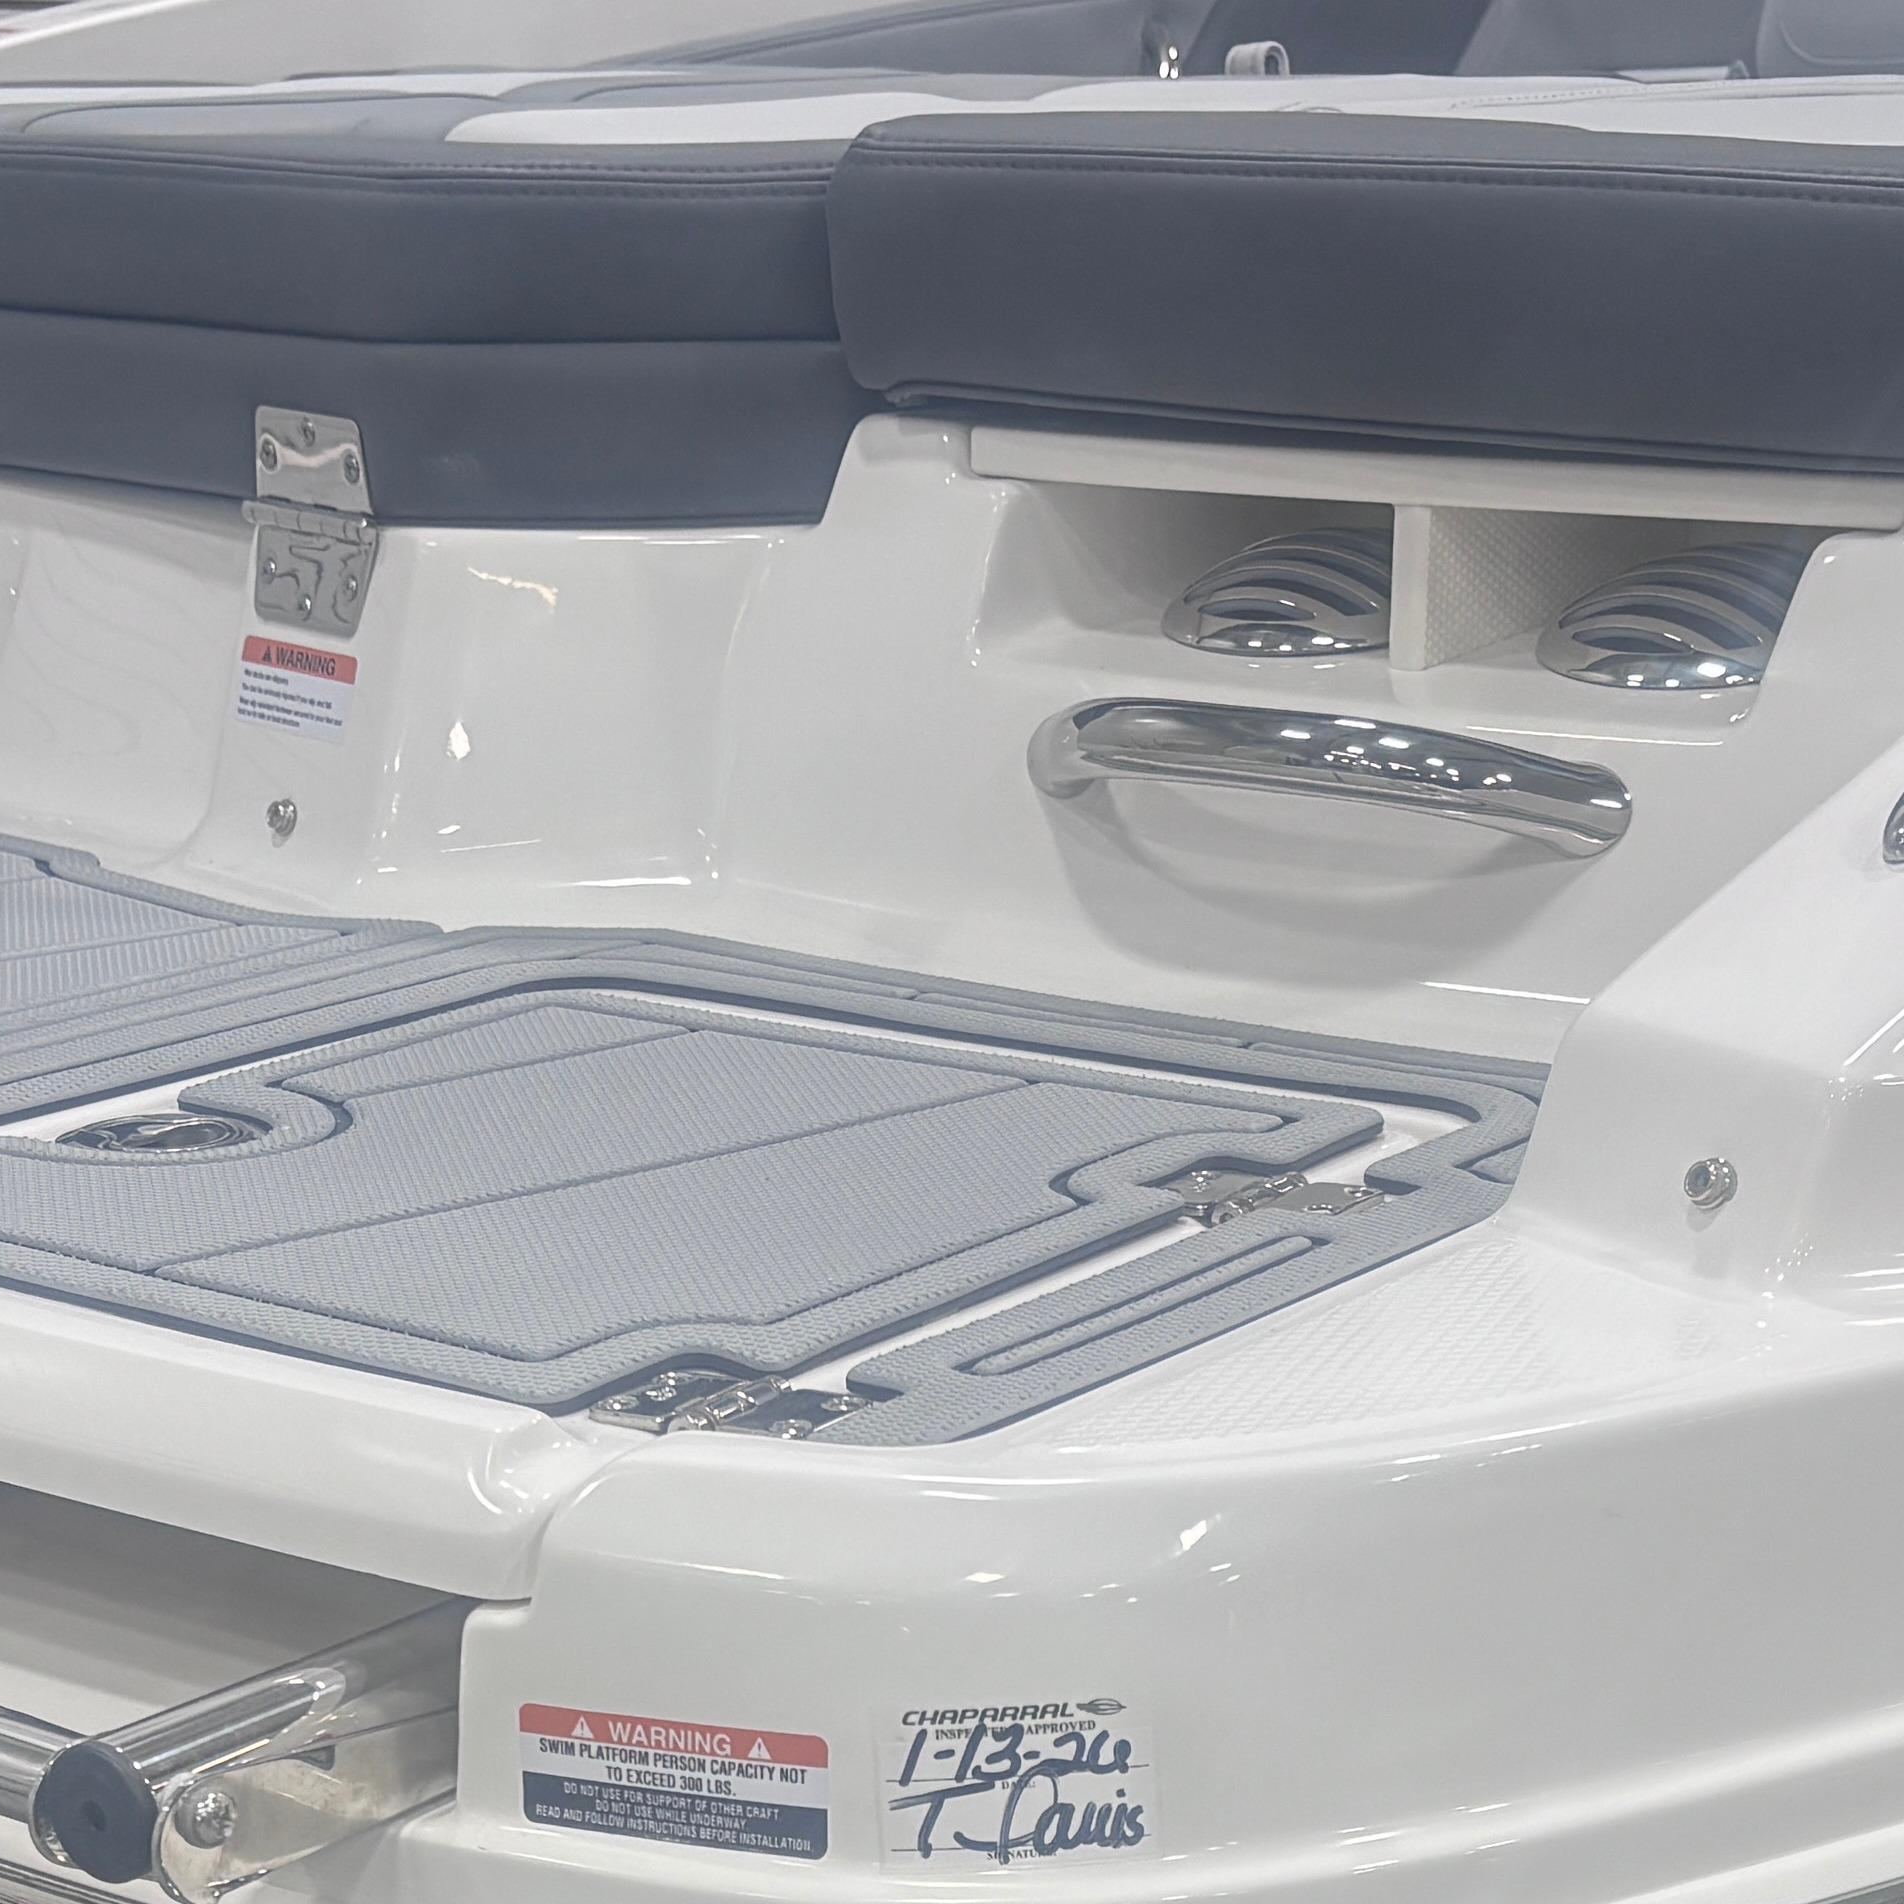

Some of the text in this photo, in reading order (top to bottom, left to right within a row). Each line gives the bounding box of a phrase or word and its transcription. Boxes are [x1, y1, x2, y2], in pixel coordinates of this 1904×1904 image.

[275, 646, 336, 676] WARNING
[901, 1702, 1075, 1726] CHAPARRAL
[1026, 1720, 1096, 1736] APPROVED
[608, 1720, 731, 1757] WARNING
[899, 1722, 1132, 1787] 1-13-26
[539, 1737, 807, 1784] SWIM PLATFORM PERSON CAPACITY NOT
[606, 1766, 736, 1796] TO EXCEED 300 LBS.
[564, 1782, 779, 1820] DO NOT USE FOR SUPPORT OF OTHER CRAFT
[596, 1799, 747, 1829] DO NOT USE WHILE UNDERWAY
[536, 1803, 560, 1818] READ
[563, 1808, 583, 1822] AND
[585, 1811, 625, 1828] FOLLOW
[627, 1817, 697, 1838] INSTRUCTIONS
[699, 1827, 736, 1843] BEFORE
